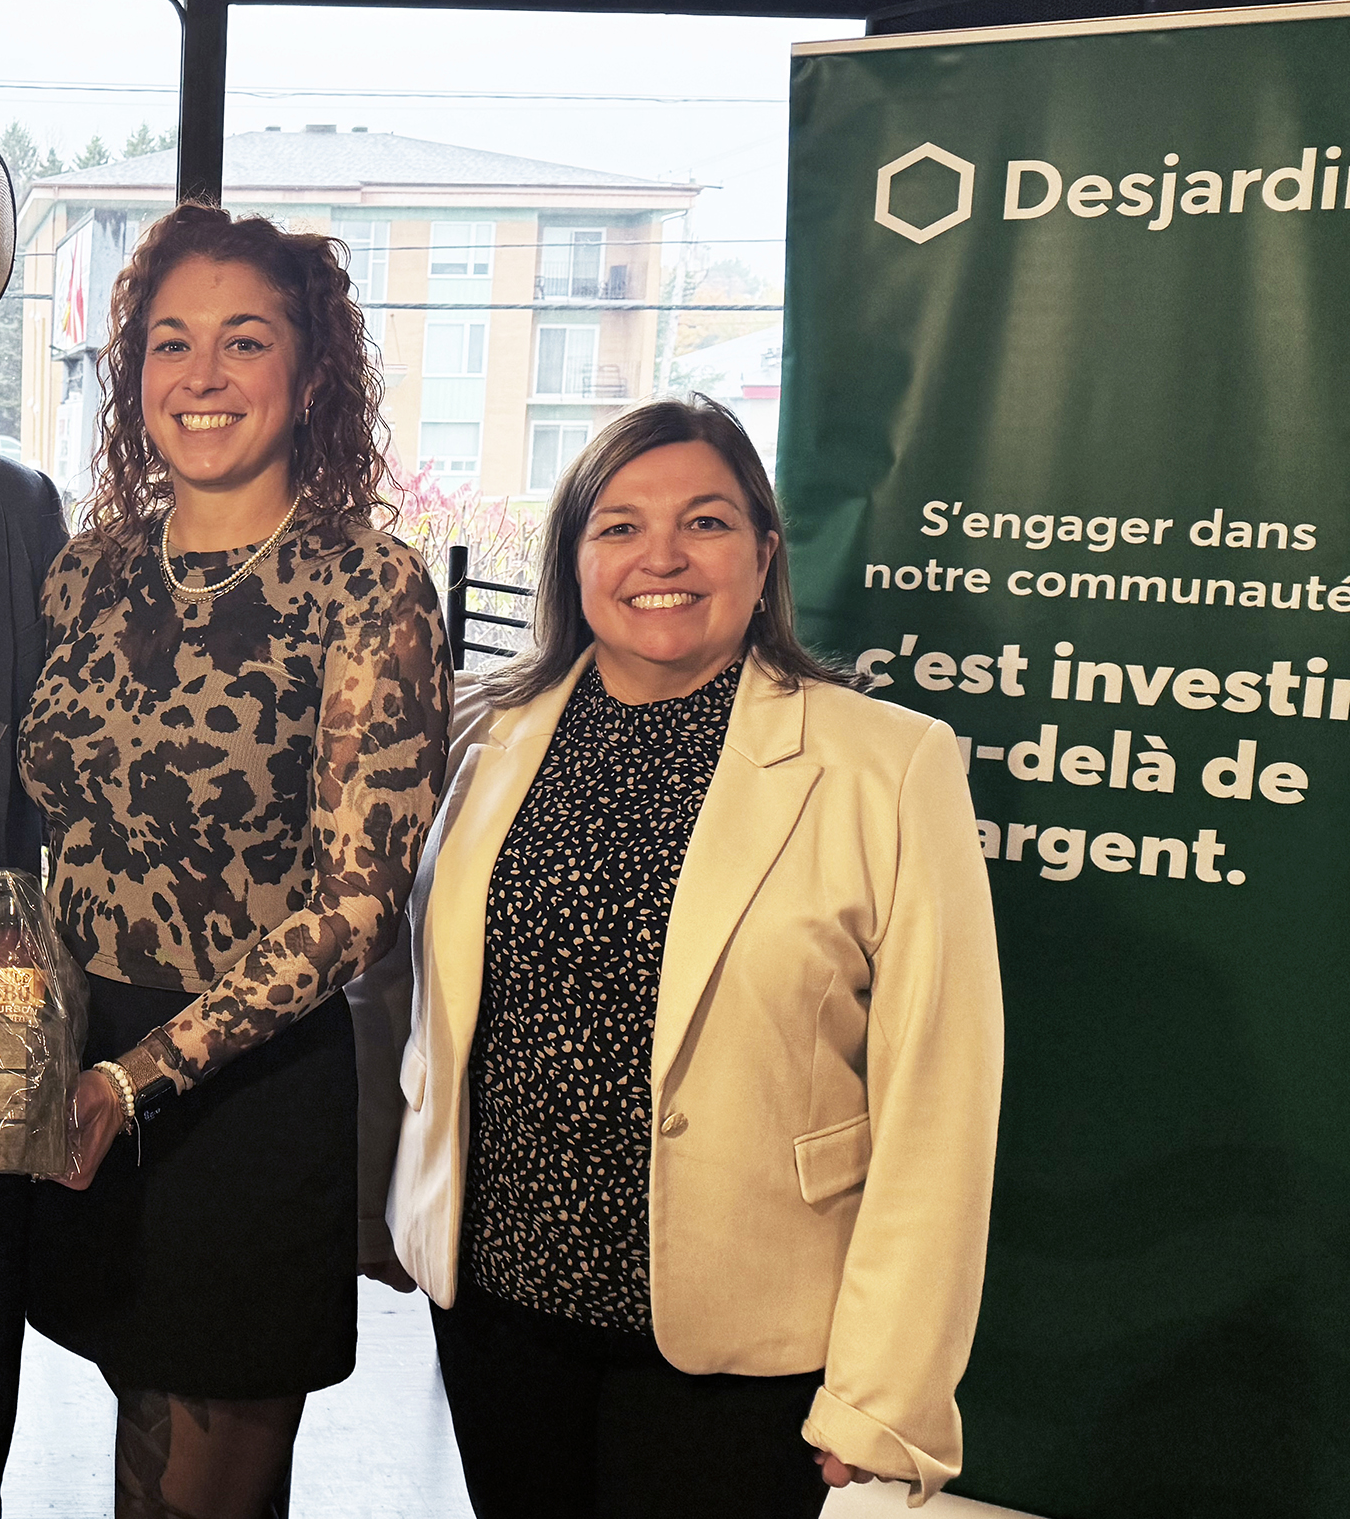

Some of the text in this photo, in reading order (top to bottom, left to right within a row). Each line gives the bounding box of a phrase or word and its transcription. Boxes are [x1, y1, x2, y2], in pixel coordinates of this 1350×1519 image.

[1003, 145, 1350, 231] Desjardi
[920, 500, 1317, 552] S'engager dans
[864, 559, 1350, 613] notre communauté
[856, 633, 1028, 697] c'est
[1201, 739, 1309, 805] de
